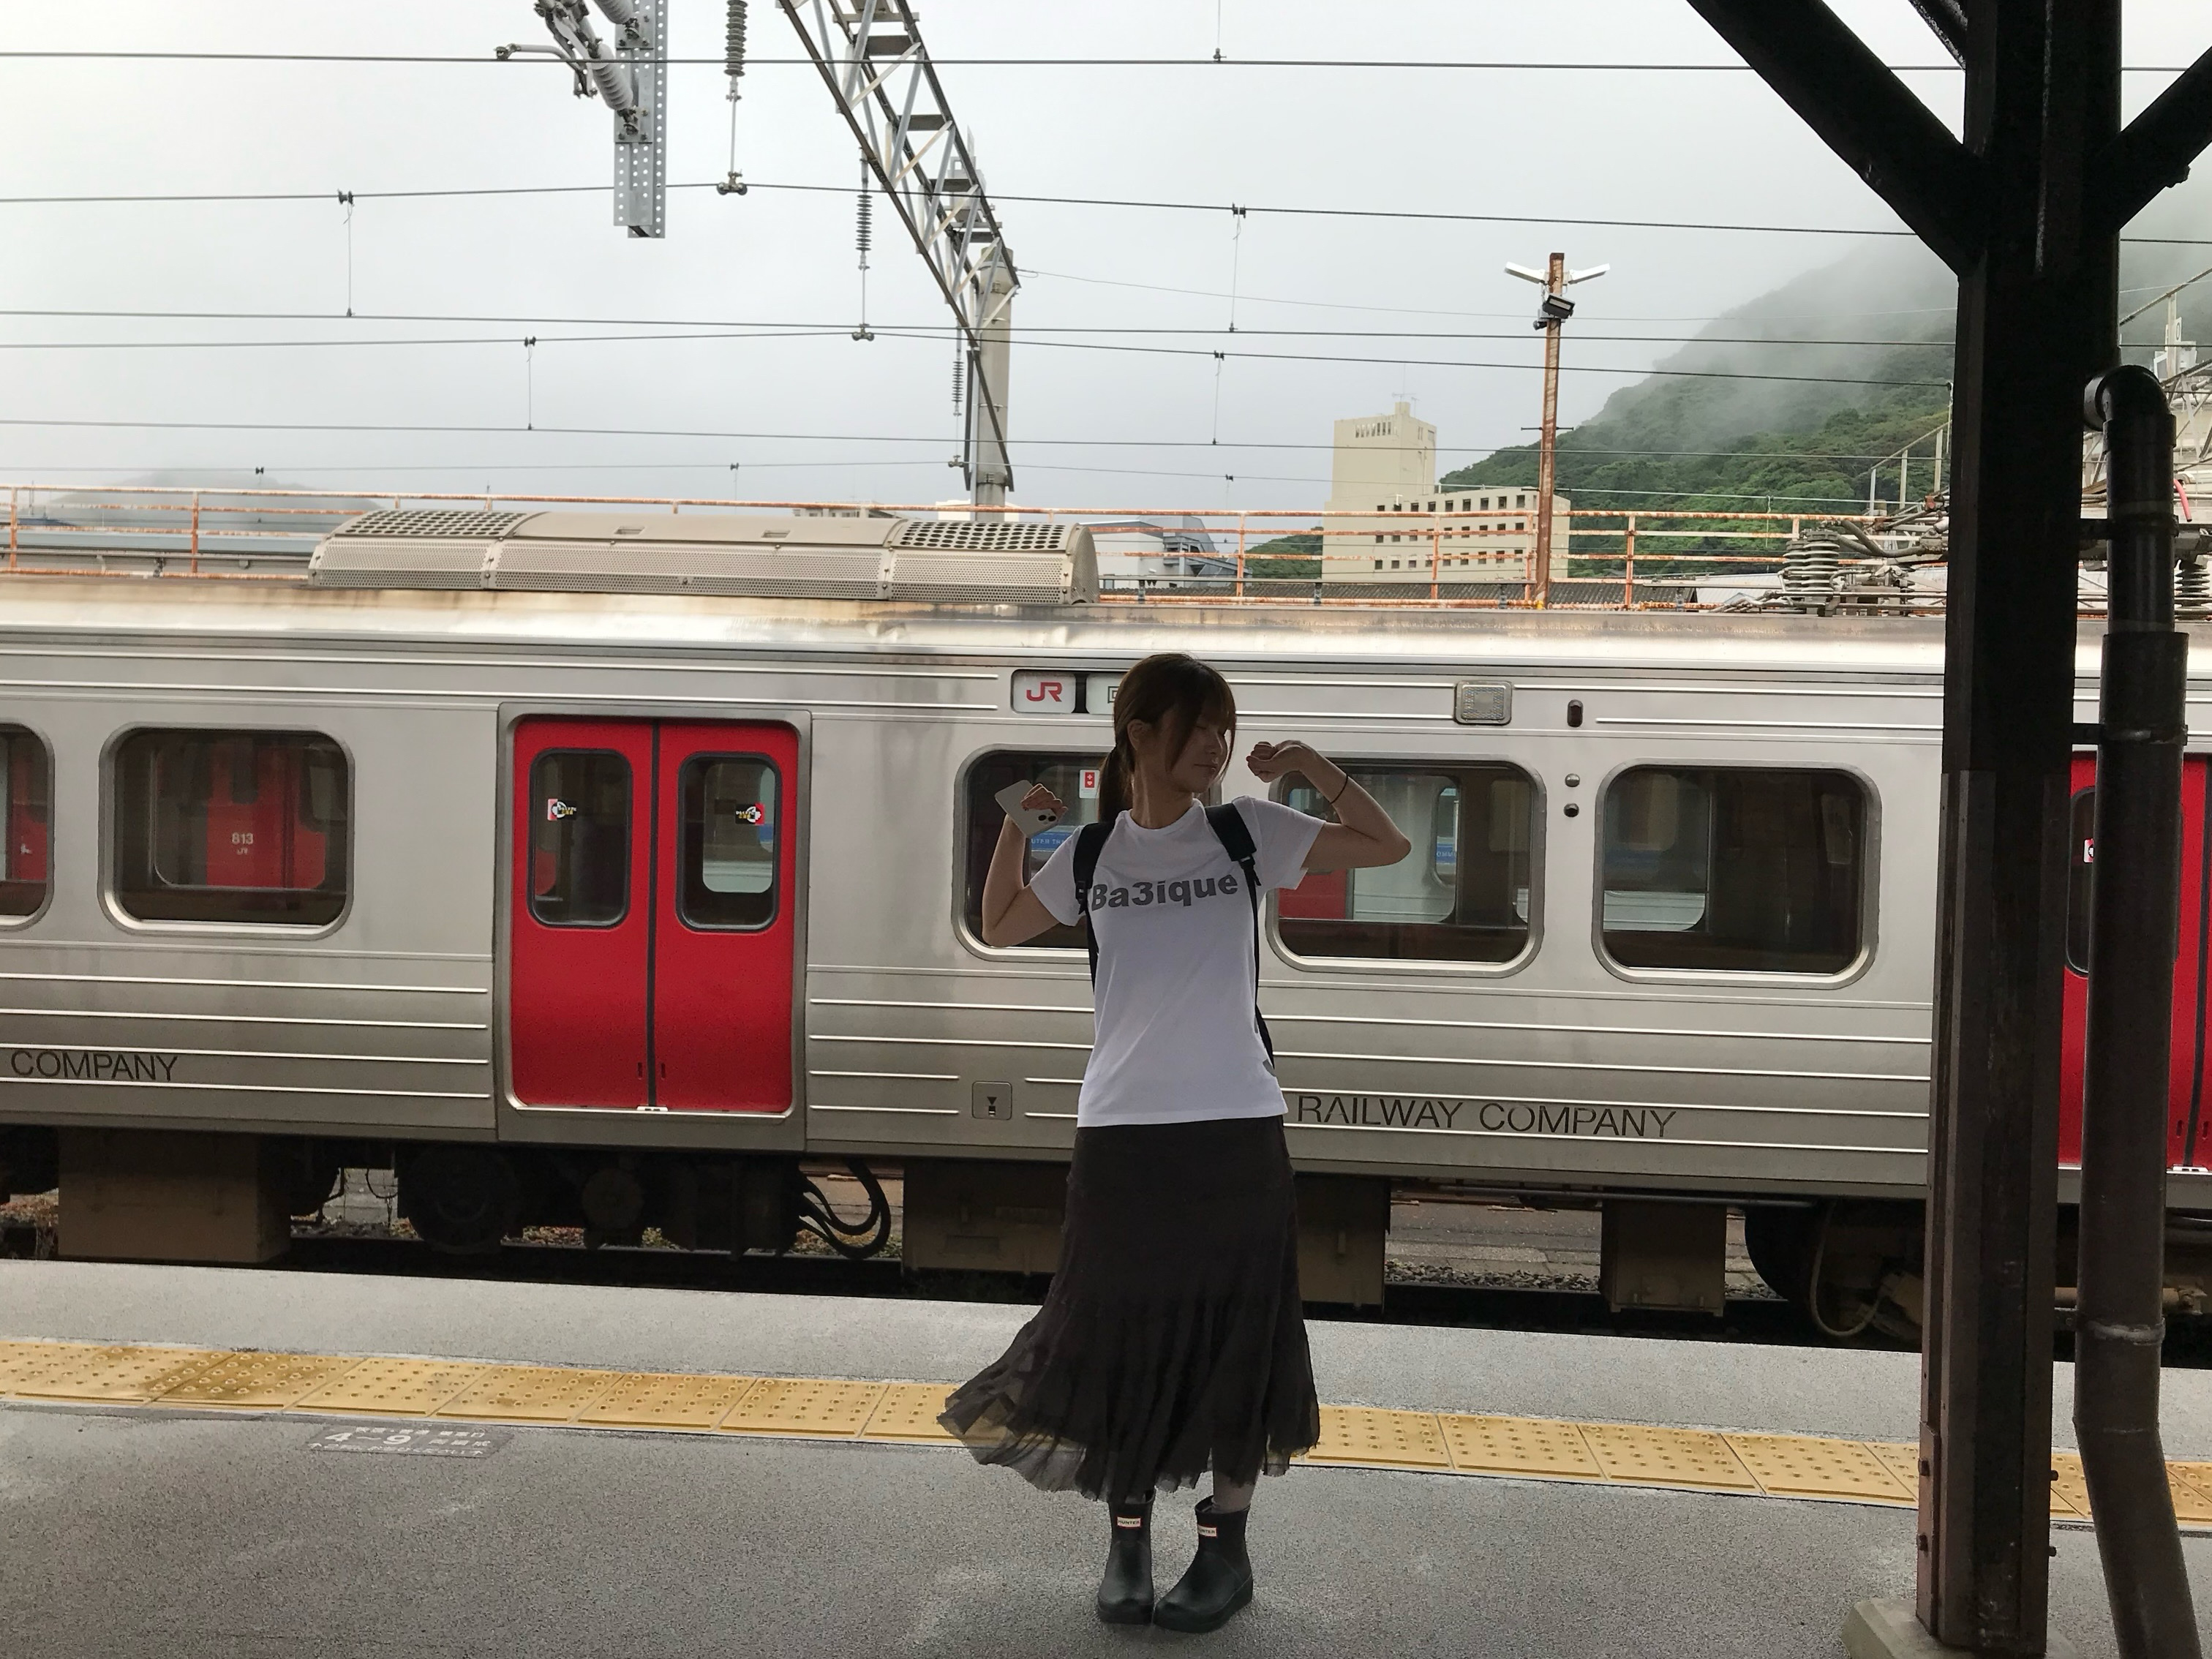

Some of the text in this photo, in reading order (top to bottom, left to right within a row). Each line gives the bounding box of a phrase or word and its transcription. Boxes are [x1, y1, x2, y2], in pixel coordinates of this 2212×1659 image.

[1026, 682, 1062, 702] JR
[232, 832, 254, 845] 813
[1091, 874, 1238, 911] Ba3ique
[11, 1050, 178, 1081] COMPANY
[1297, 1095, 1677, 1137] RAILWAY COMPANY
